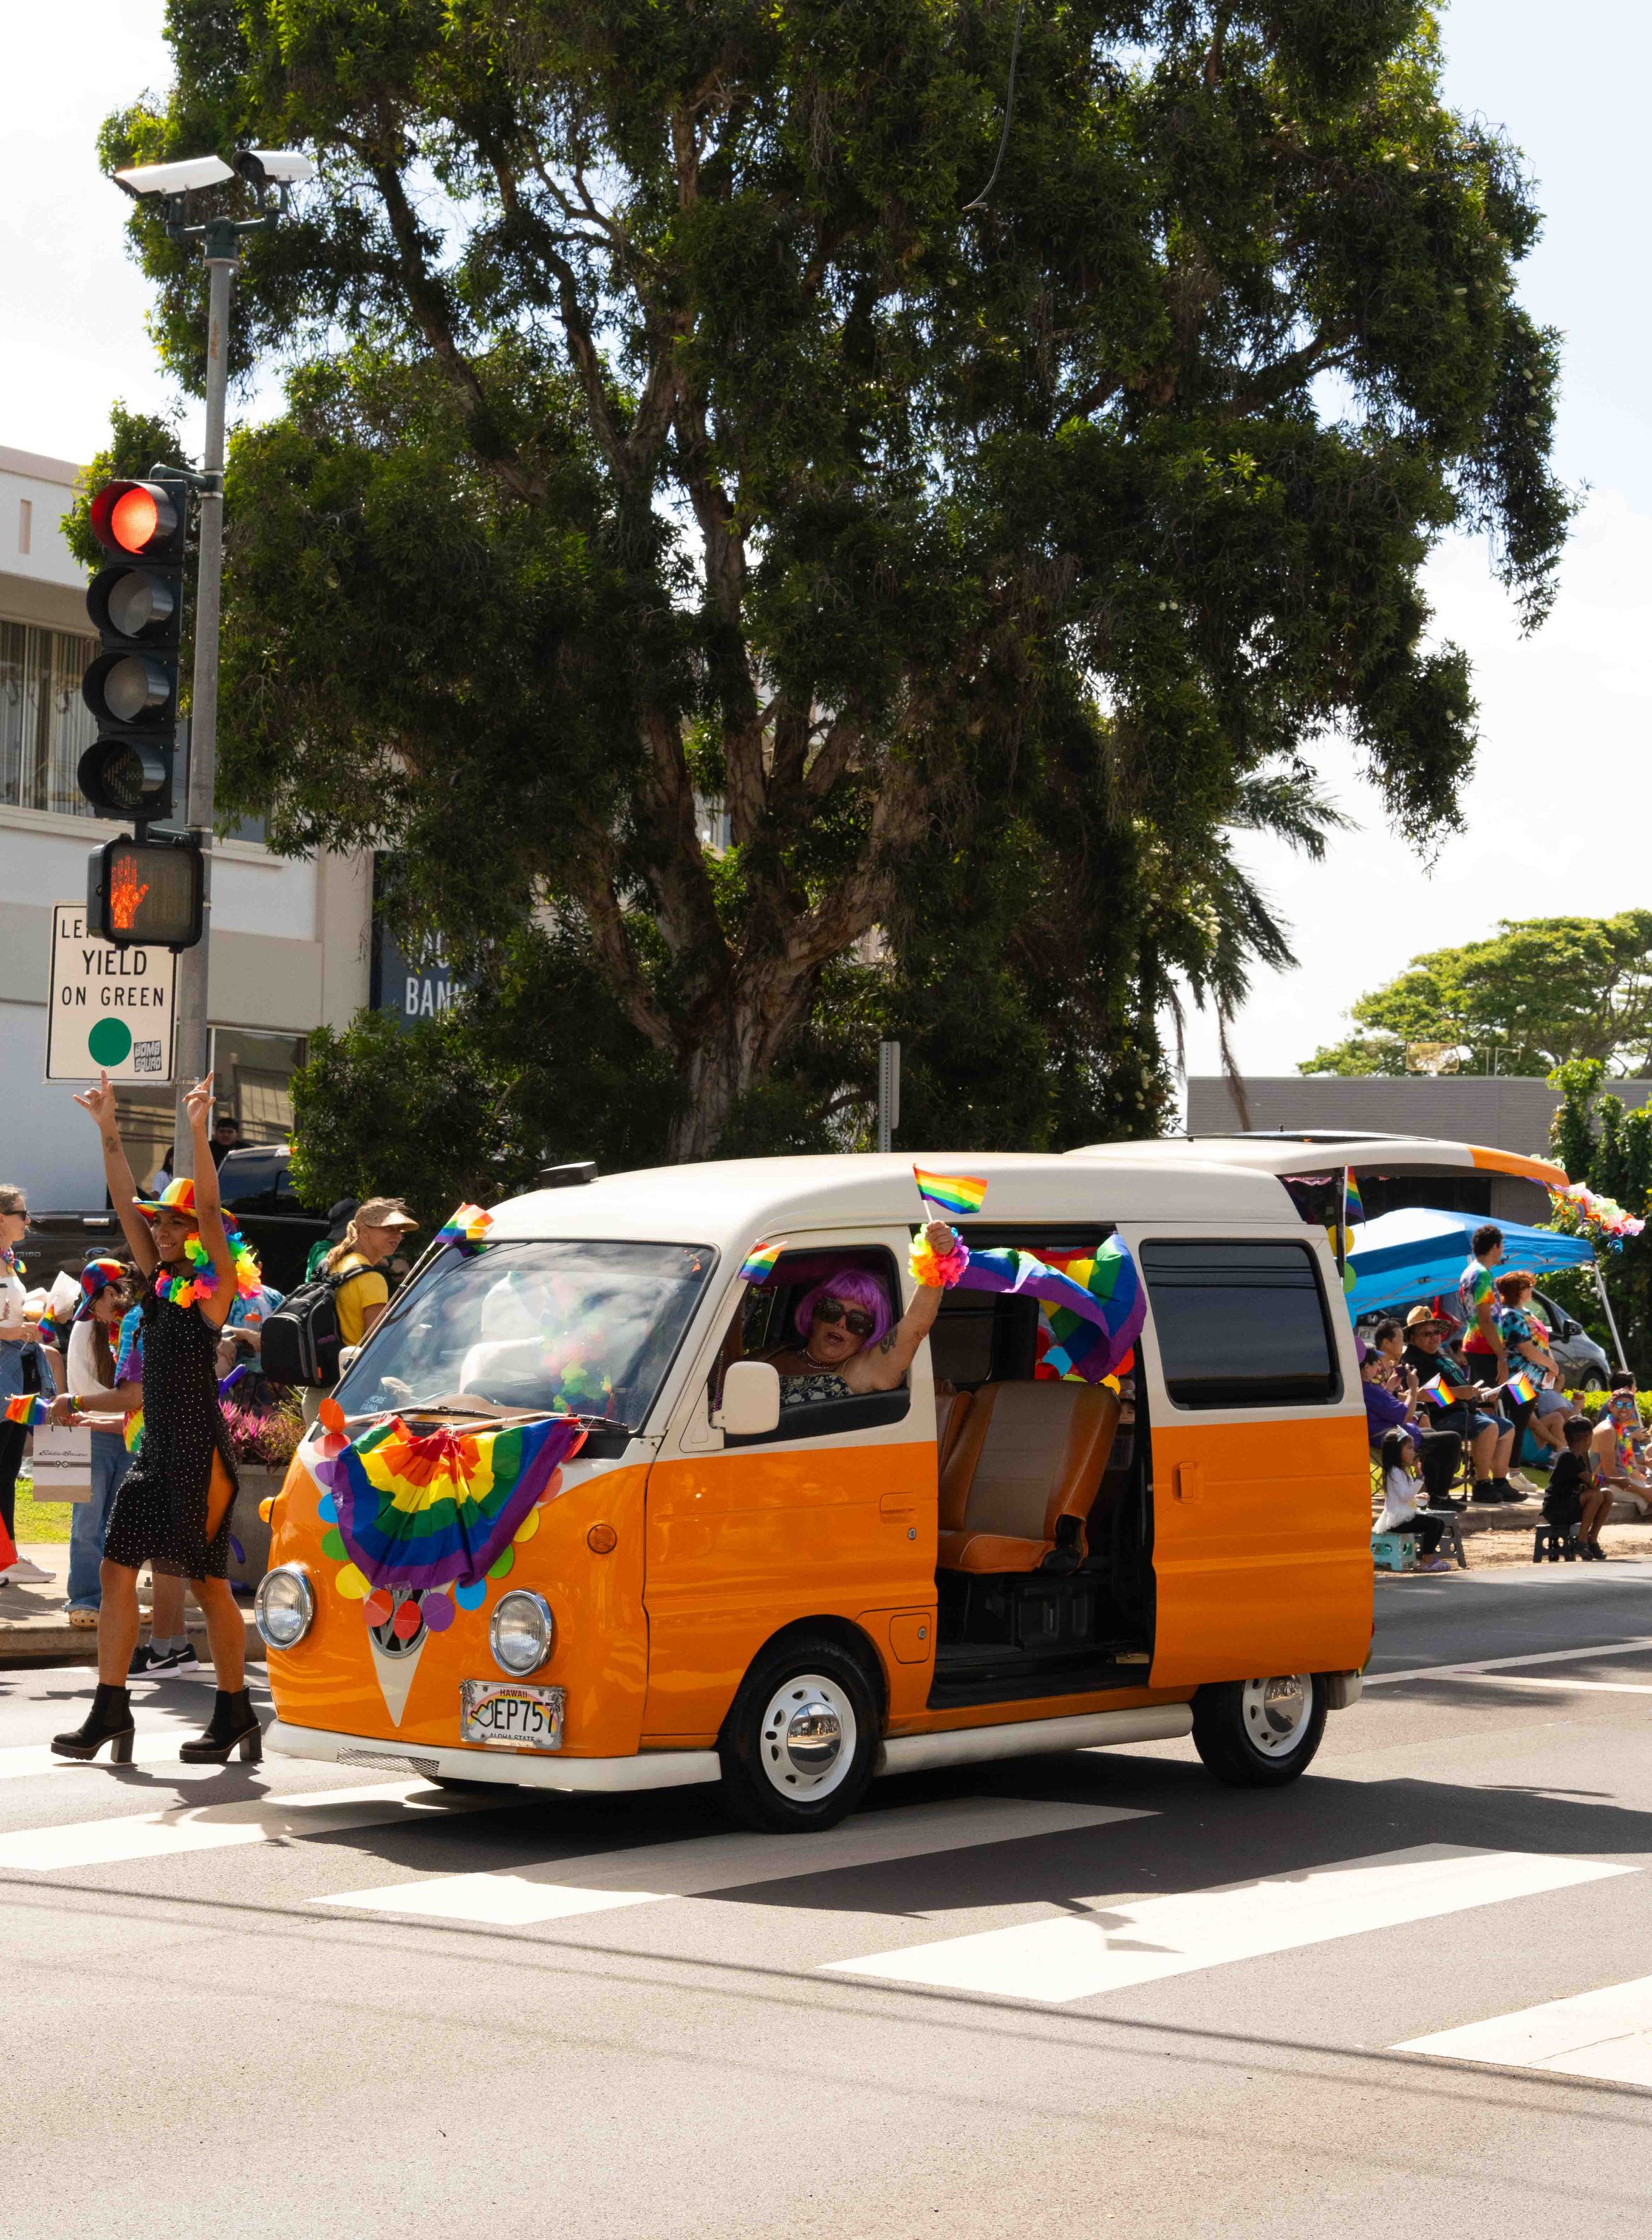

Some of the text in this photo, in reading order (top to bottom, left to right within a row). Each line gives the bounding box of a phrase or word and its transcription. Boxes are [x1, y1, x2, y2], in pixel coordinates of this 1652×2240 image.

[61, 919, 89, 939] LE
[82, 949, 147, 976] YIELD
[61, 985, 164, 1007] ON GREEN
[135, 1042, 161, 1057] BOMB
[135, 1056, 161, 1072] SQUAD
[500, 1689, 528, 1698] HAWAII
[494, 1698, 554, 1734] EP757
